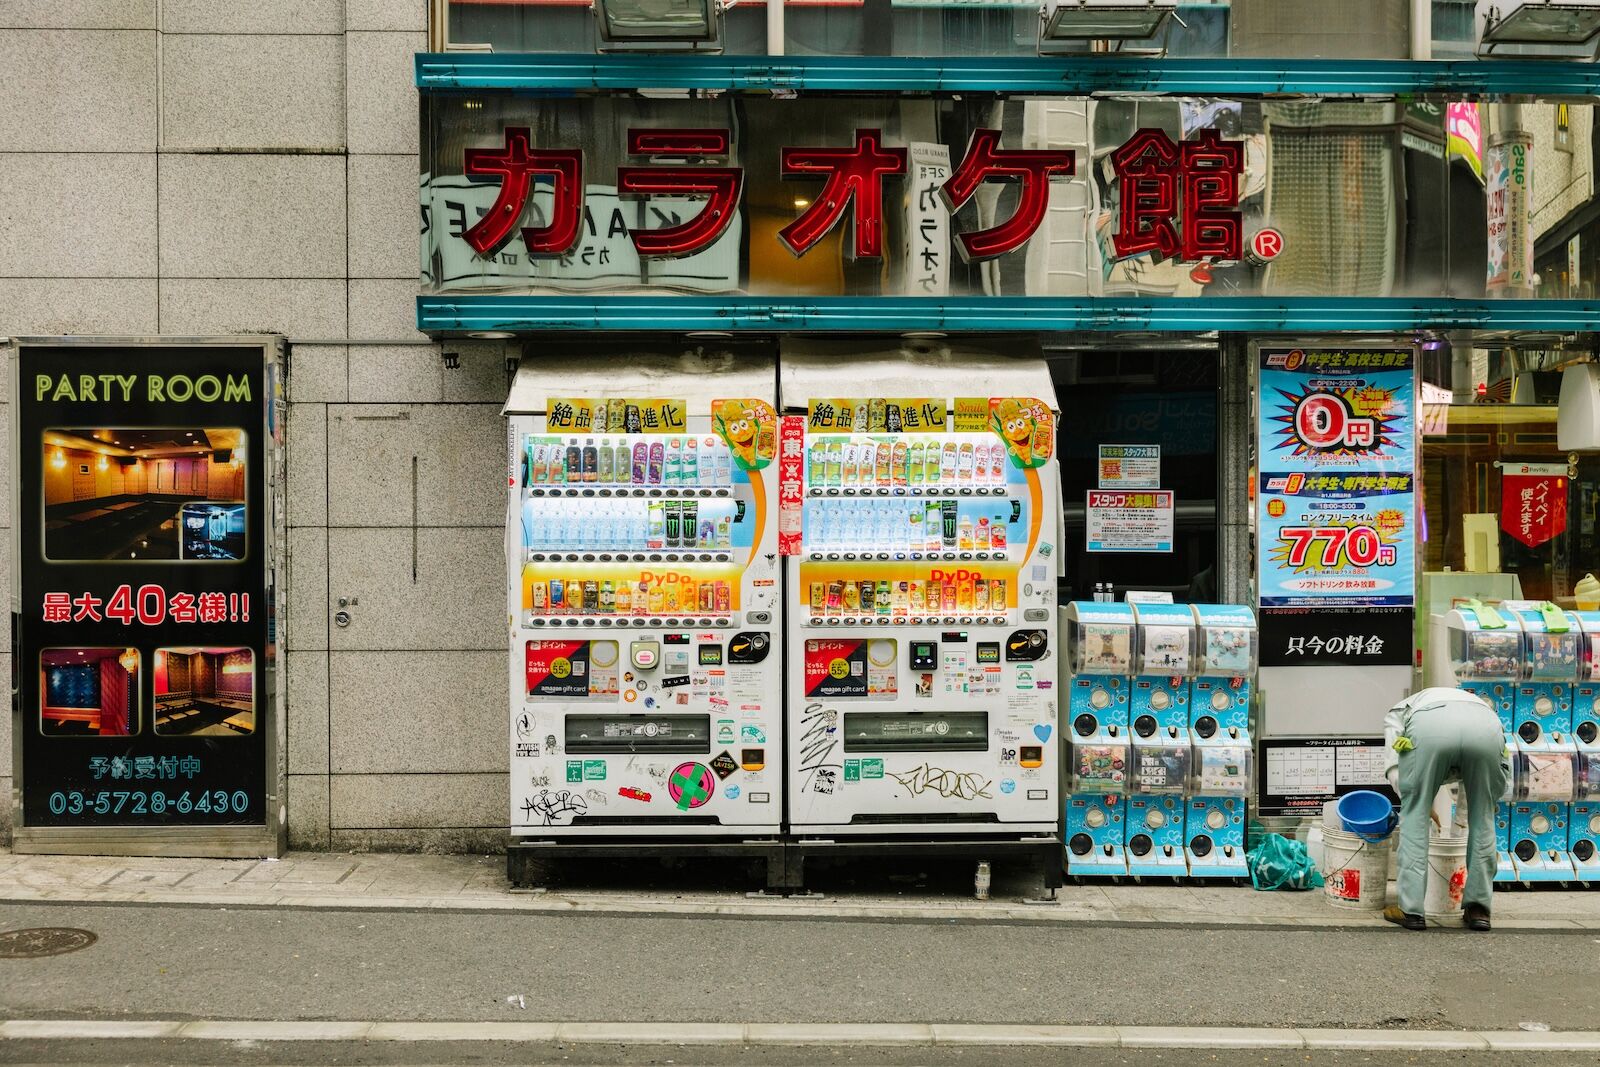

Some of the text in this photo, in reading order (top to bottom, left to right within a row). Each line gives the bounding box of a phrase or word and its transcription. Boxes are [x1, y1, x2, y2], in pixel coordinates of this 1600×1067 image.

[462, 127, 1244, 261] カラオケ館
[36, 374, 252, 402] PARTY ROOM
[549, 402, 683, 428] 絶品 進化
[810, 402, 944, 428] 絶品 進化
[1299, 396, 1371, 444] 0円
[1521, 488, 1534, 541] 使えます。
[1535, 480, 1549, 525] ペイペイ
[1301, 514, 1374, 522] ロングフリータイム
[1281, 527, 1395, 564] 770円
[640, 571, 692, 586] DyDo
[931, 569, 982, 585] DyDo
[1299, 580, 1376, 588] ソフトドリンク飲み放題
[43, 584, 250, 625] 最大40名様!!
[1285, 635, 1385, 656] 只今の料金
[563, 685, 573, 693] gift
[89, 755, 201, 780] 予約受付中
[713, 761, 735, 769] LAVISH
[49, 790, 249, 814] 03-5728-6430
